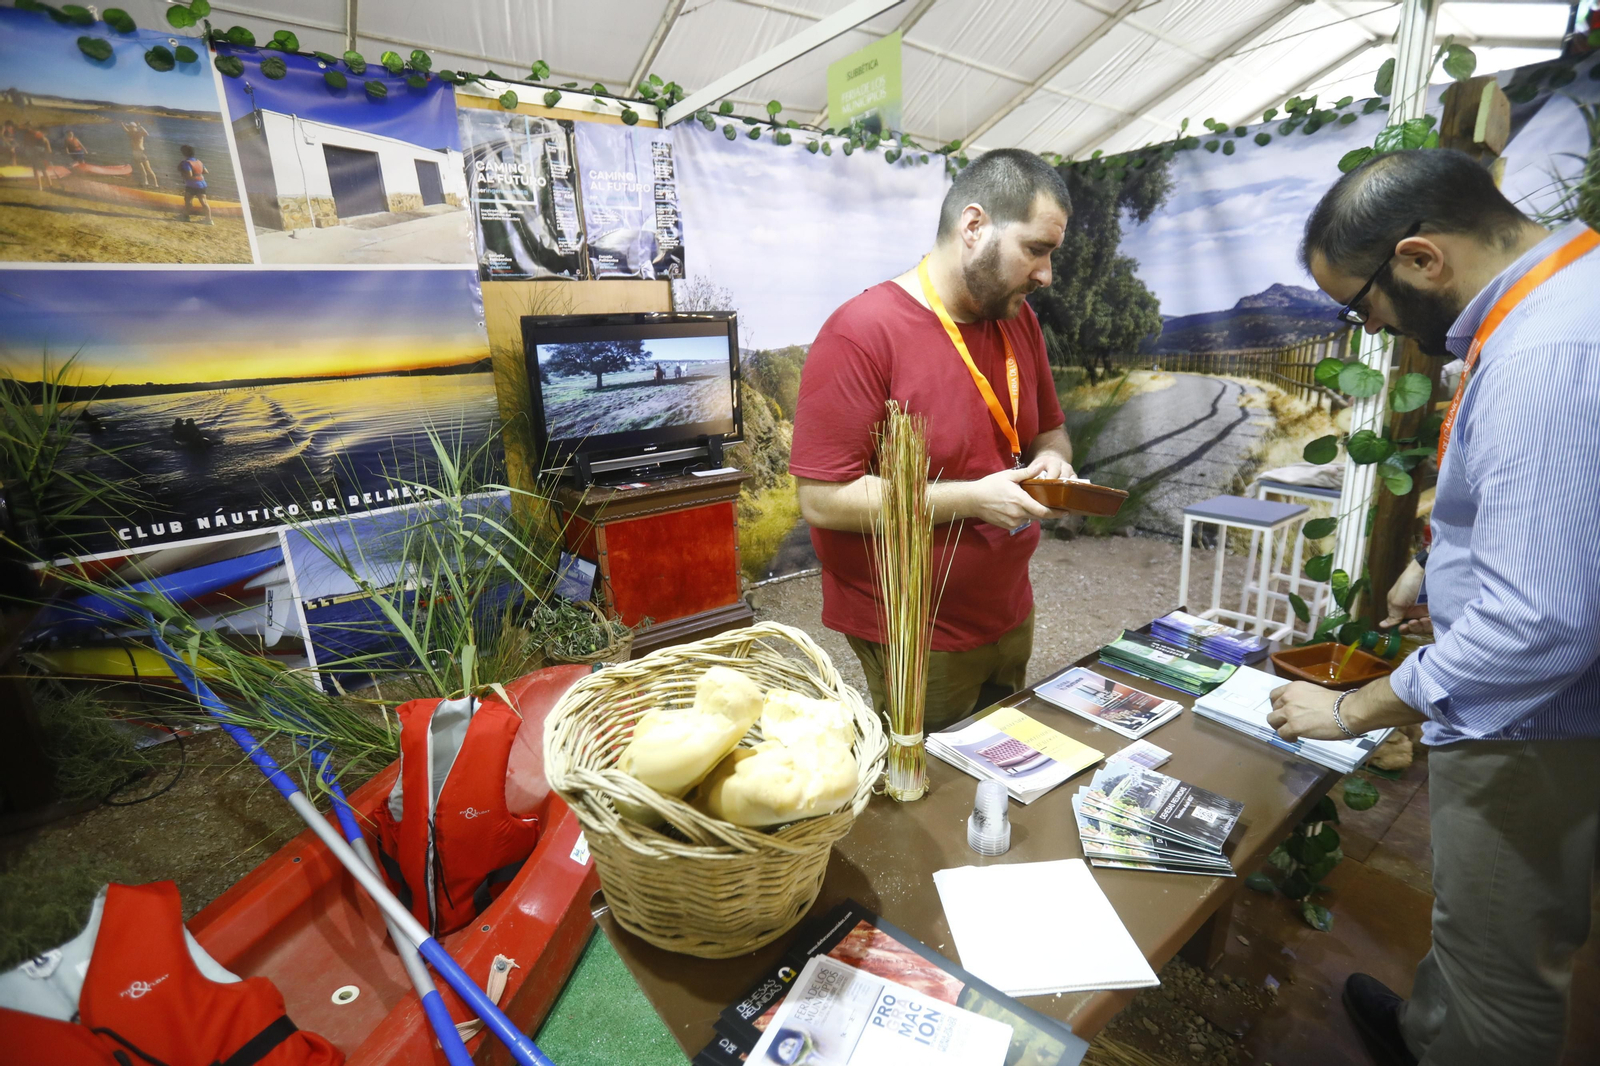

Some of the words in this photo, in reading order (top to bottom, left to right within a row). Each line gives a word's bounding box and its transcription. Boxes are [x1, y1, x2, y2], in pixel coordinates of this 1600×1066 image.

[842, 90, 887, 112] MUNICIPIOS
[475, 160, 527, 174] CAMINO
[477, 172, 495, 184] AL
[497, 174, 547, 187] FUTURO
[589, 169, 634, 181] CAMINO
[590, 181, 606, 191] AL
[607, 182, 652, 193] FUTURO
[118, 521, 183, 541] CLUB
[197, 504, 299, 530] NÁUTICO
[312, 498, 337, 512] DE
[348, 486, 424, 507] BELMEZ
[736, 978, 776, 1012] DEHESAS
[741, 984, 783, 1020] REUNIDAS
[794, 995, 813, 1020] FERIA
[808, 984, 820, 997] DE
[816, 967, 831, 985] LOS
[804, 971, 839, 1024] MUNICIPIOS
[872, 994, 897, 1028] PRO
[886, 999, 909, 1031] GRA
[898, 1001, 922, 1037] MAC
[914, 1008, 942, 1045] ION
